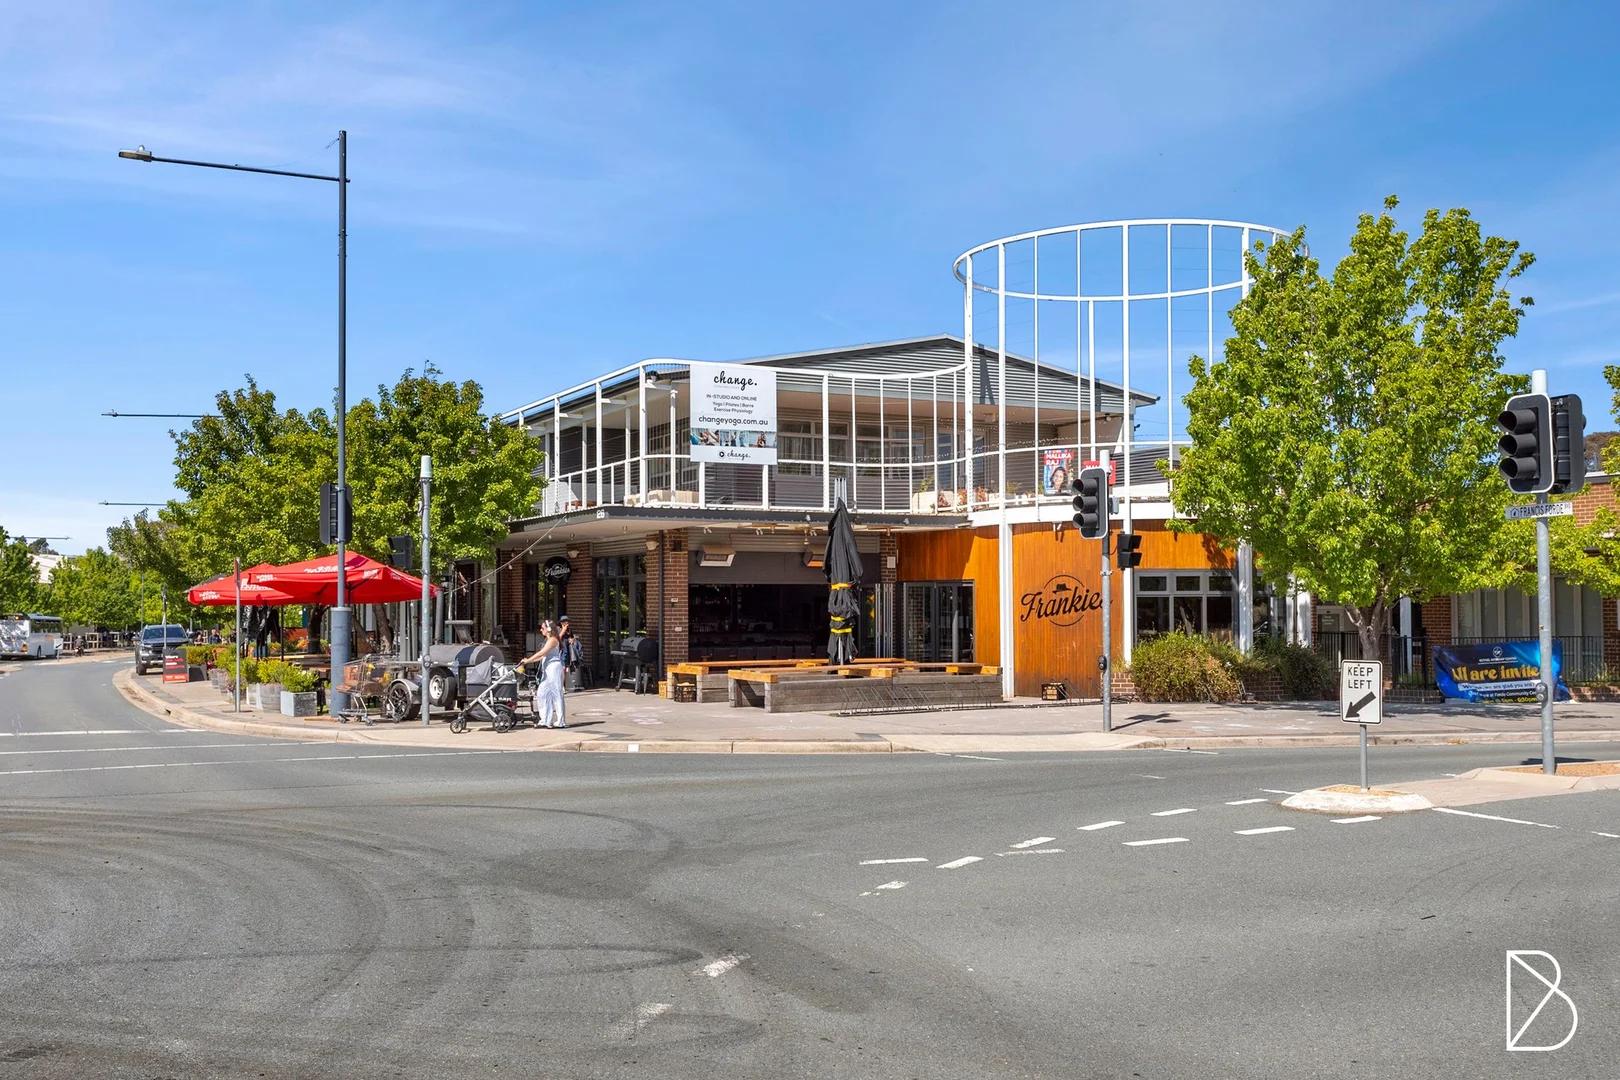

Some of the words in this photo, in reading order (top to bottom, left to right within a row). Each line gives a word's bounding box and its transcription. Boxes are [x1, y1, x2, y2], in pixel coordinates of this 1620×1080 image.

[714, 371, 757, 391] change.
[699, 416, 768, 426] changeyoga.com.au
[1520, 505, 1544, 517] FRANCIS
[1545, 503, 1563, 515] FORDE
[1347, 666, 1374, 677] KEEP
[1472, 668, 1498, 681] are
[1348, 679, 1372, 689] LEFT
